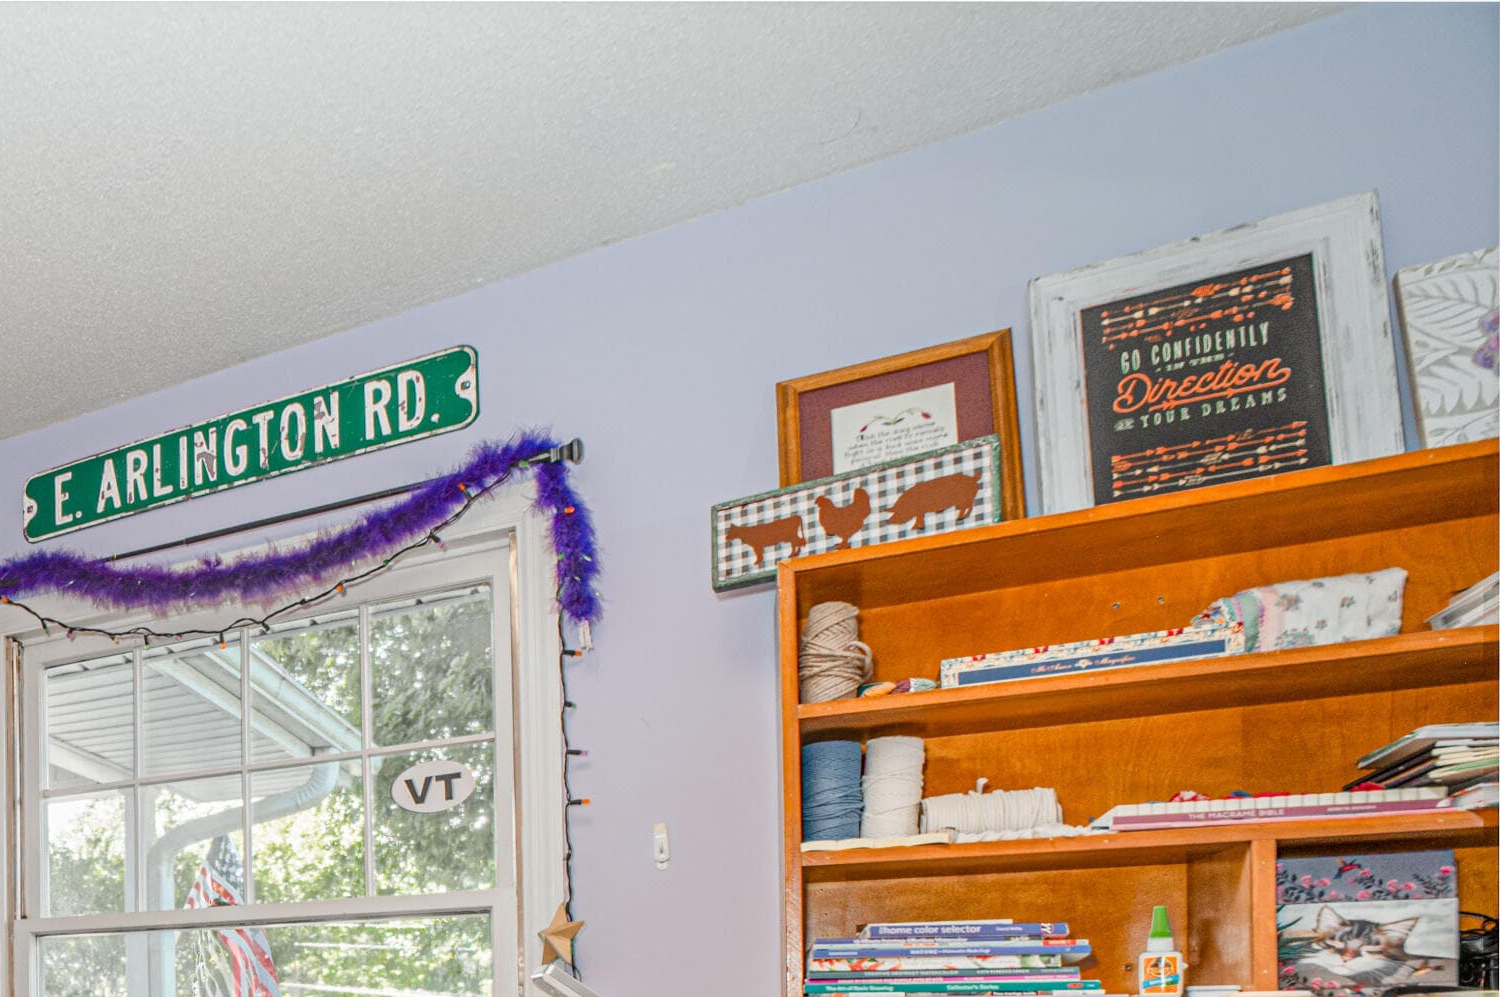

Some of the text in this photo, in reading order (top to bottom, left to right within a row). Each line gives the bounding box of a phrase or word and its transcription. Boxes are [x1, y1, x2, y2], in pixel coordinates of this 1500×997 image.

[1120, 321, 1270, 375] GO CONFIDENTLY
[1112, 357, 1292, 414] Direction
[1140, 406, 1191, 429] YOUR
[1201, 387, 1288, 417] DREAMS
[54, 369, 441, 526] E. ARLINGTON RD.
[404, 771, 462, 805] VT
[884, 925, 913, 935] home
[914, 924, 939, 934] color
[941, 923, 982, 934] selector
